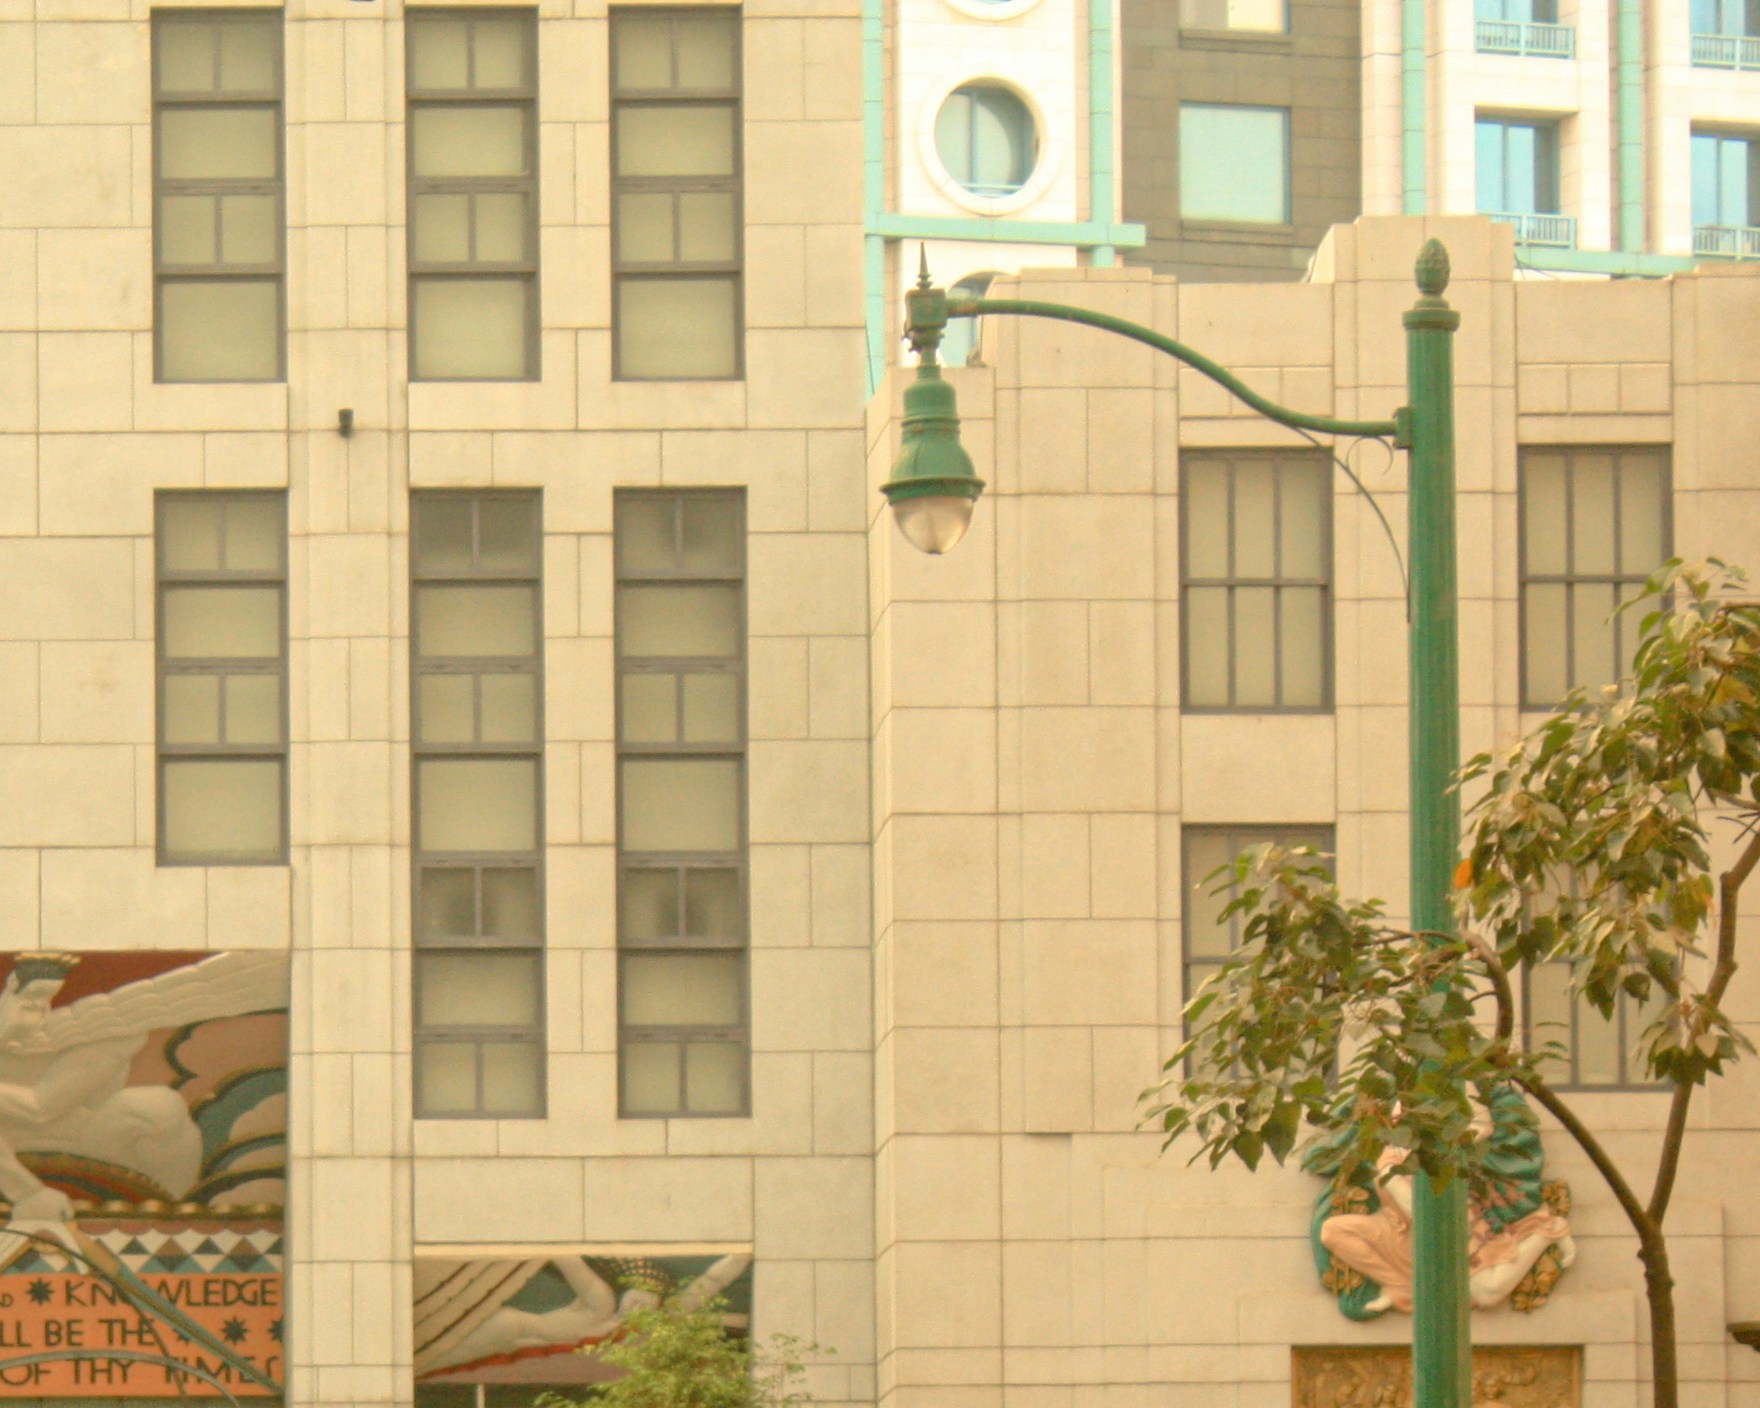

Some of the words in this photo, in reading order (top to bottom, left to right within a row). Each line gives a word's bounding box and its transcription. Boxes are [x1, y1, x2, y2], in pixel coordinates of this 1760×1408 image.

[65, 1278, 278, 1306] KNWLEDGE
[45, 1319, 84, 1346] BE
[98, 1318, 155, 1346] THE
[65, 1356, 135, 1384] THY
